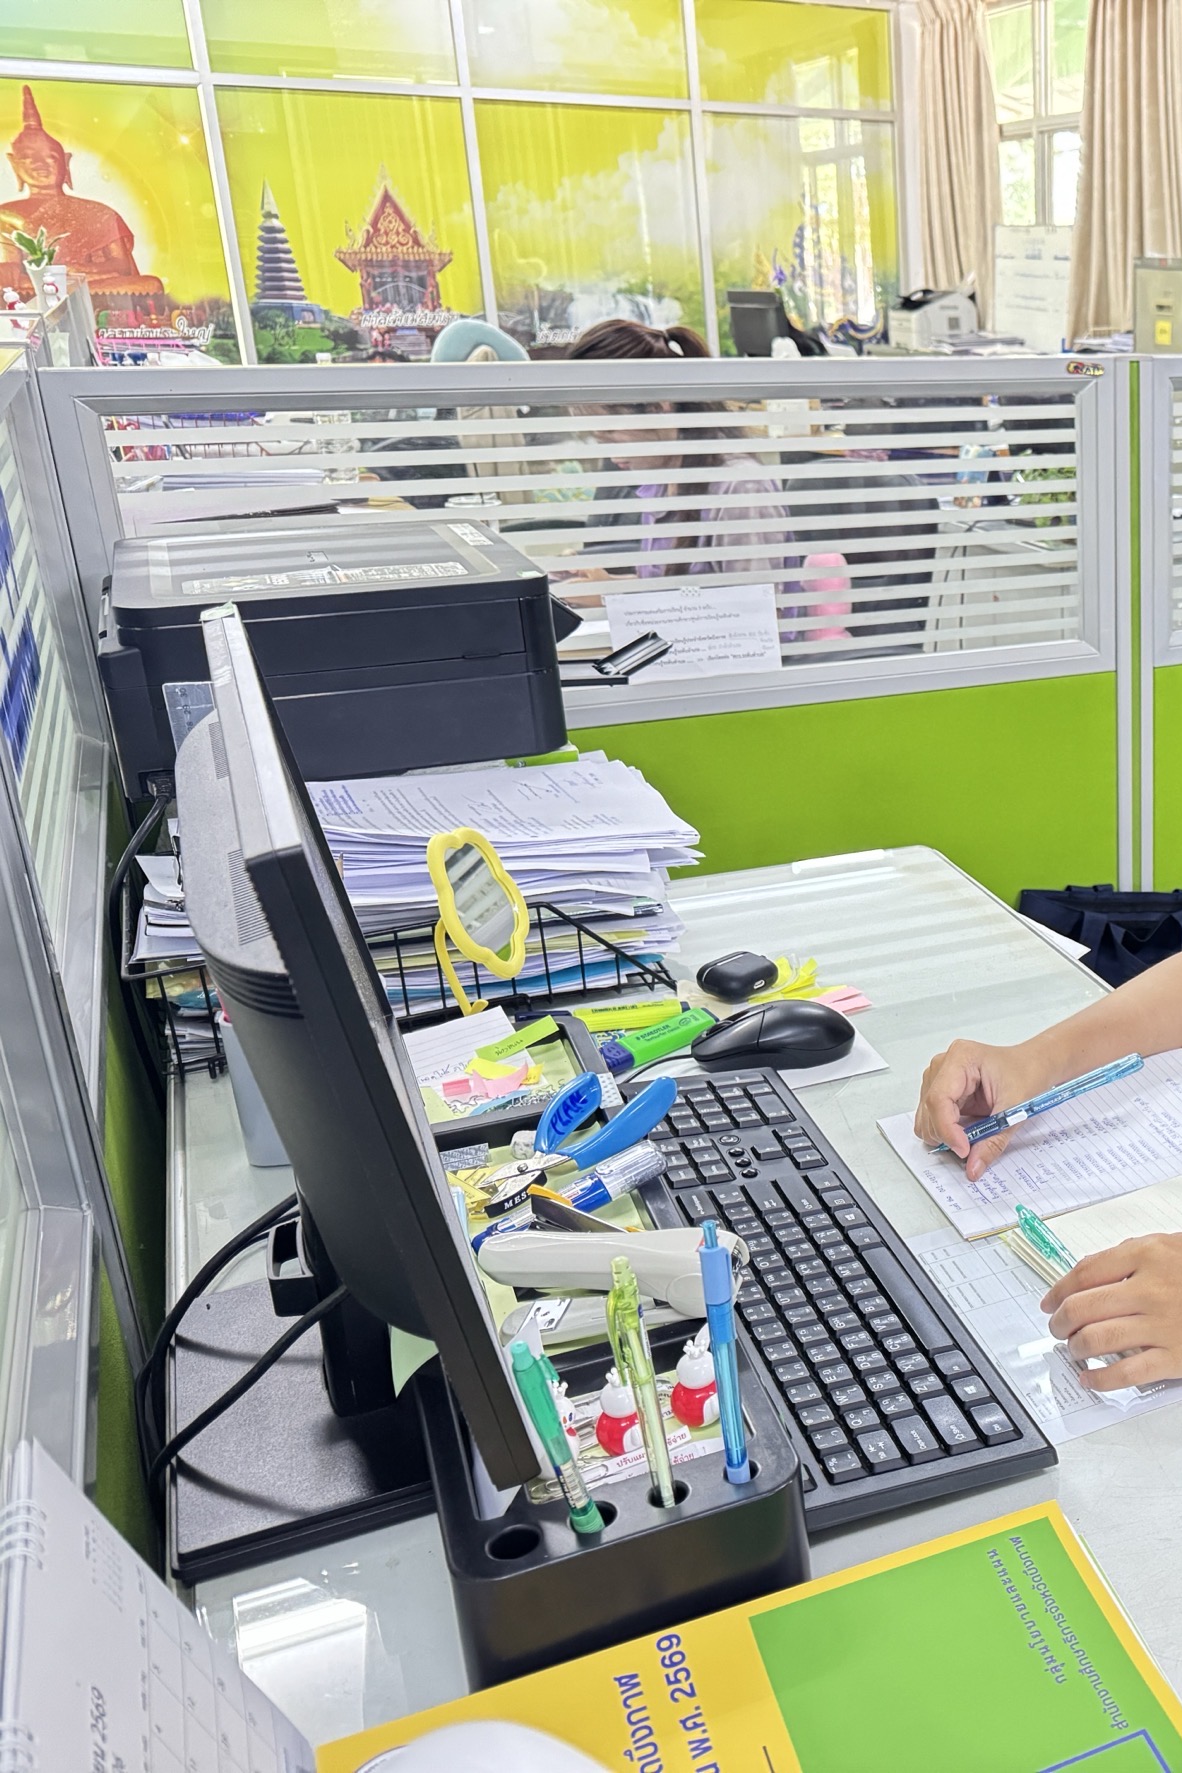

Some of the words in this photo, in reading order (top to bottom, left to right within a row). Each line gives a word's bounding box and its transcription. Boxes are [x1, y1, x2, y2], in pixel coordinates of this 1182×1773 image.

[640, 1023, 671, 1039] STAEDTLER
[550, 1089, 589, 1136] PLAN
[504, 1189, 531, 1211] MES
[836, 1396, 848, 1404] W
[616, 1452, 647, 1469] ปรับแผ
[986, 1547, 1070, 1686] กลุ่มนโยบายและแผน
[1008, 1534, 1130, 1732] สำนักงานศึกษาธิการจังหวัดบึงกาฬ
[656, 1633, 697, 1703] 2569
[90, 1685, 107, 1743] 2569
[679, 1705, 713, 1760] พ.ศ.
